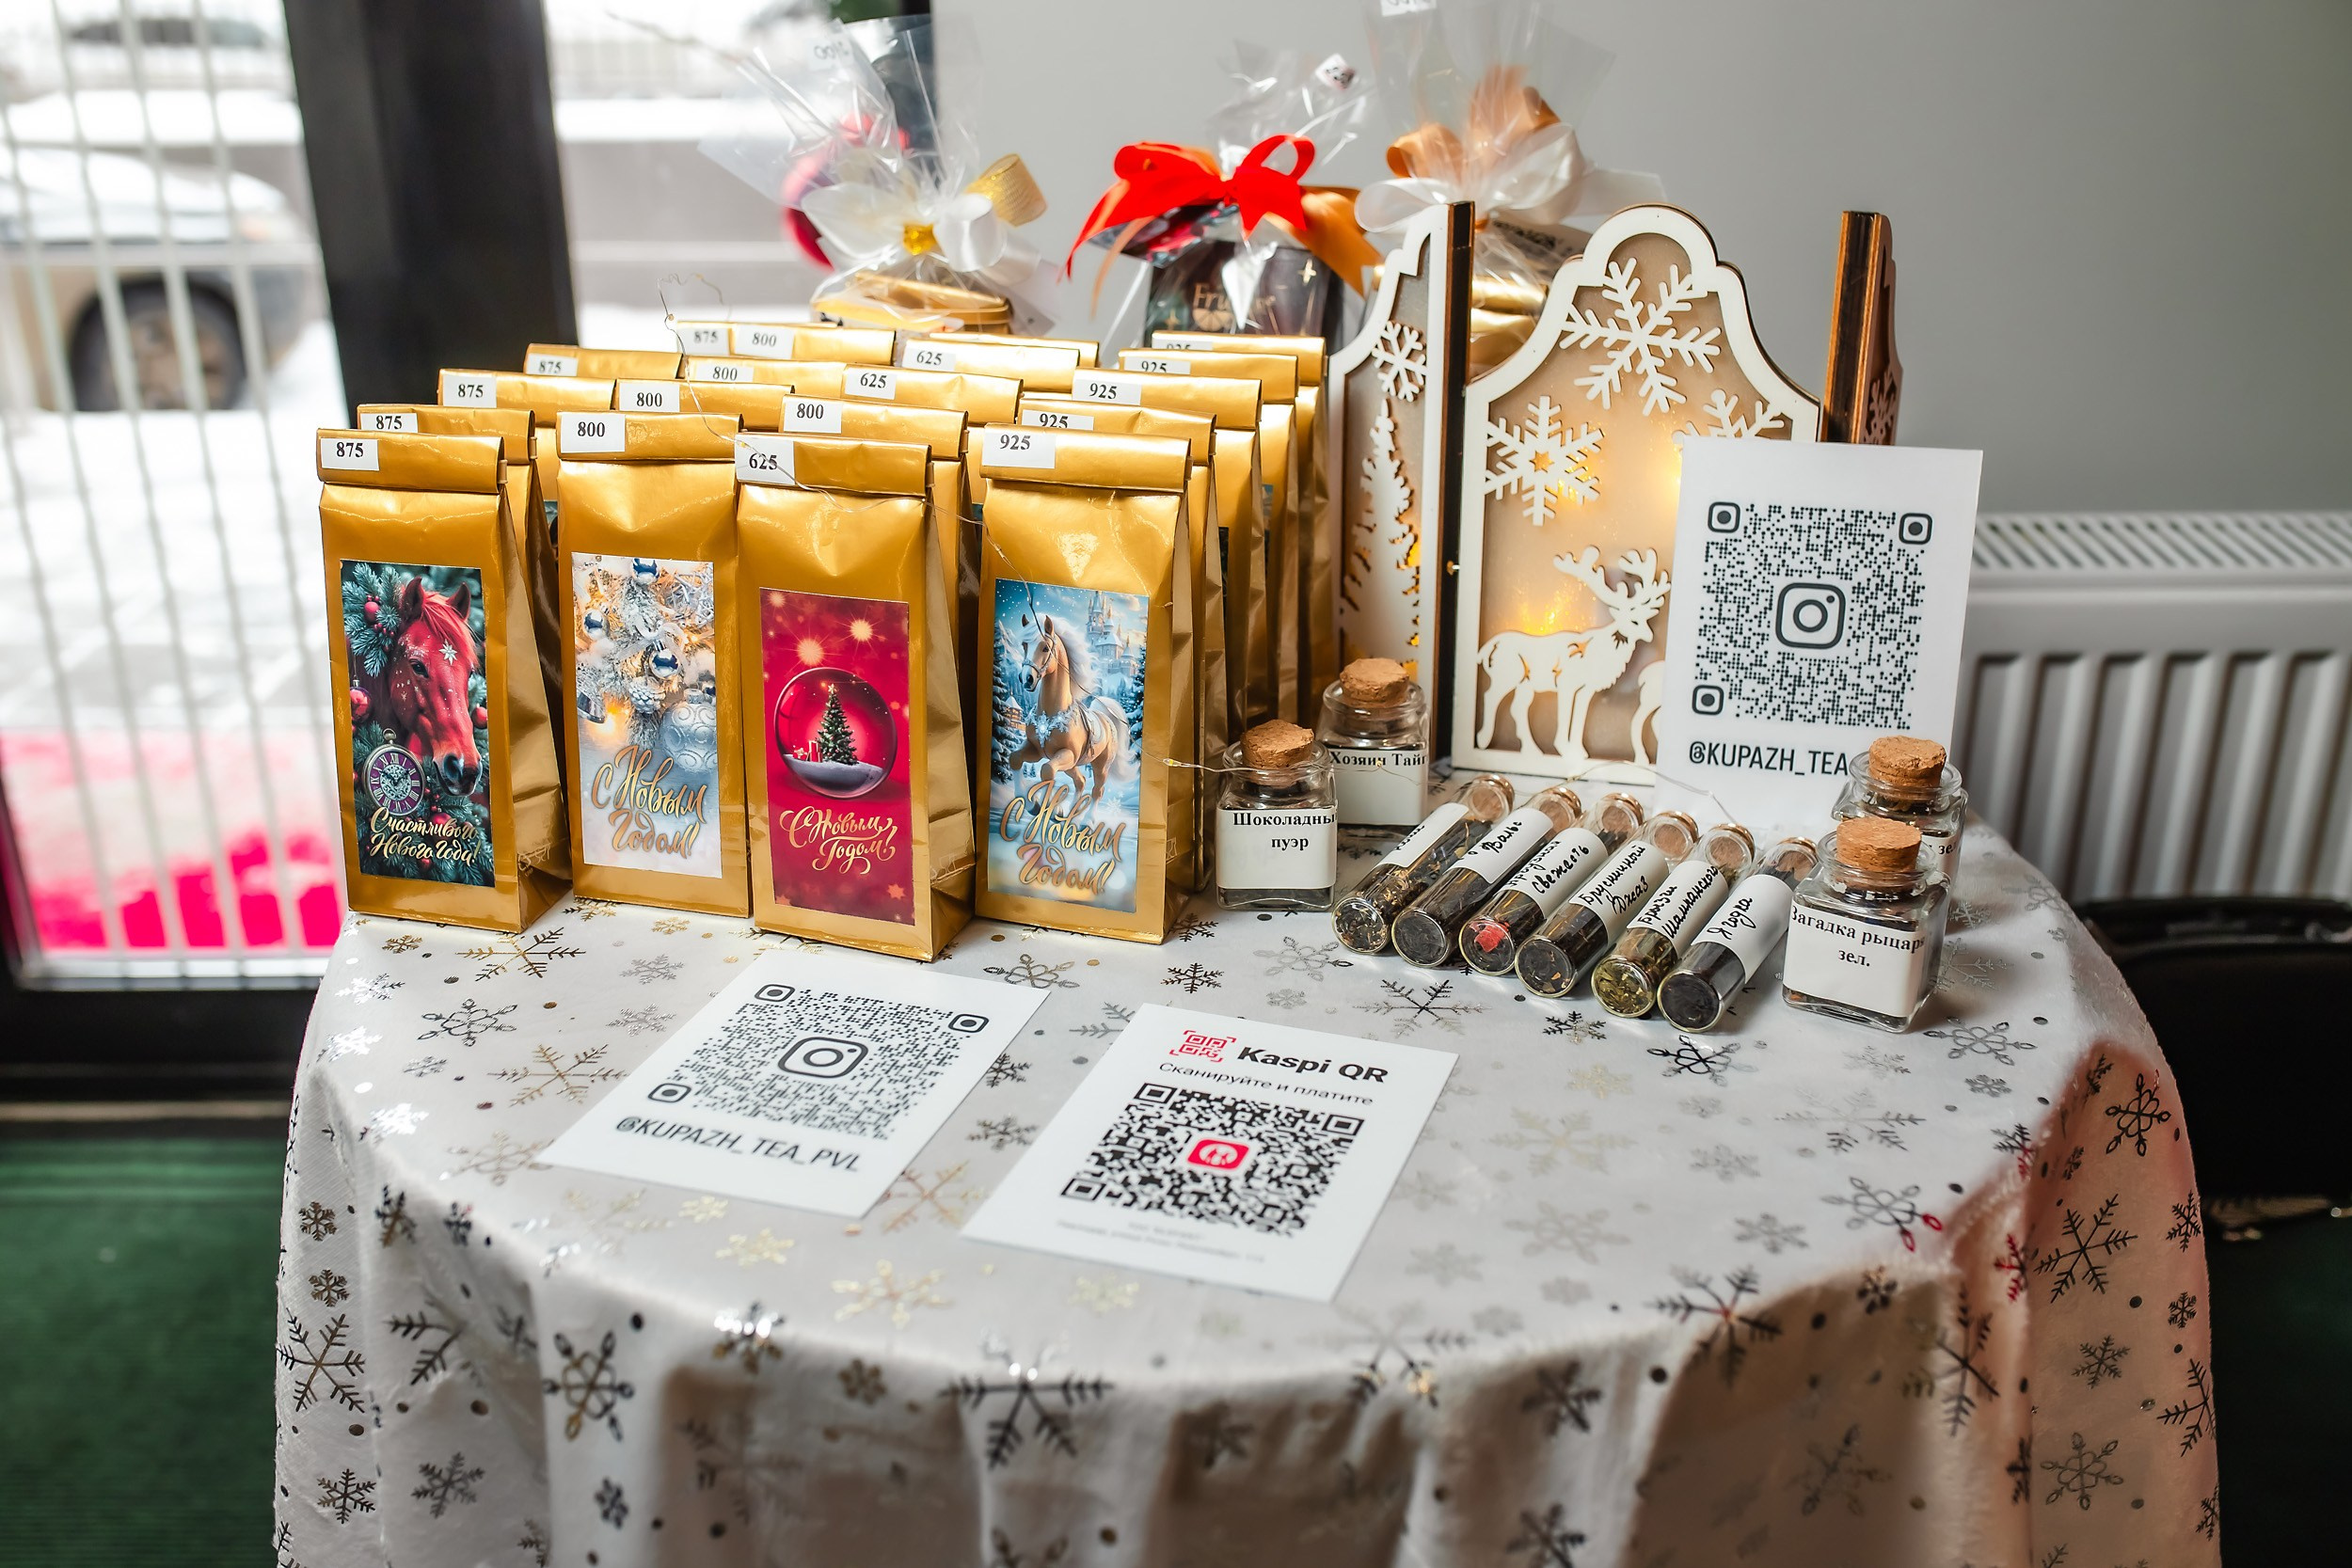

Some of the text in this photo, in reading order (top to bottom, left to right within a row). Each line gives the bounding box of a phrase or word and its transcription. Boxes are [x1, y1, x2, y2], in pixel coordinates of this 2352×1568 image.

[693, 332, 719, 344] 875
[752, 333, 777, 347] 800
[538, 359, 563, 374] 875
[915, 351, 943, 366] 625
[1141, 361, 1168, 373] 925
[712, 367, 738, 381] 800
[860, 372, 887, 388] 625
[457, 384, 484, 399] 875
[636, 391, 662, 407] 800
[1089, 383, 1117, 400] 925
[796, 403, 824, 420] 800
[374, 415, 404, 430] 875
[577, 420, 606, 437] 800
[1039, 413, 1069, 429] 925
[335, 441, 365, 458] 875
[1000, 434, 1031, 451] 925
[749, 452, 778, 470] 625
[1330, 751, 1426, 767] Хозяин Тай
[1689, 741, 1849, 777] @KUPAZH_TEA
[591, 744, 707, 824] С Новым
[370, 806, 479, 840] Счастливого
[779, 806, 894, 848] С Новым
[1000, 780, 1126, 863] С Новым
[1233, 812, 1336, 827] Шоколадны
[370, 832, 434, 860] Нового
[1271, 837, 1310, 851] пуэр
[1791, 905, 1856, 940] Загадка
[1837, 948, 1871, 968] зел.
[1237, 1046, 1389, 1084] Kaspi QR
[1159, 1062, 1375, 1106] Сканируйте и платите
[614, 1115, 862, 1173] @KUPAZH_TEA_PVL
